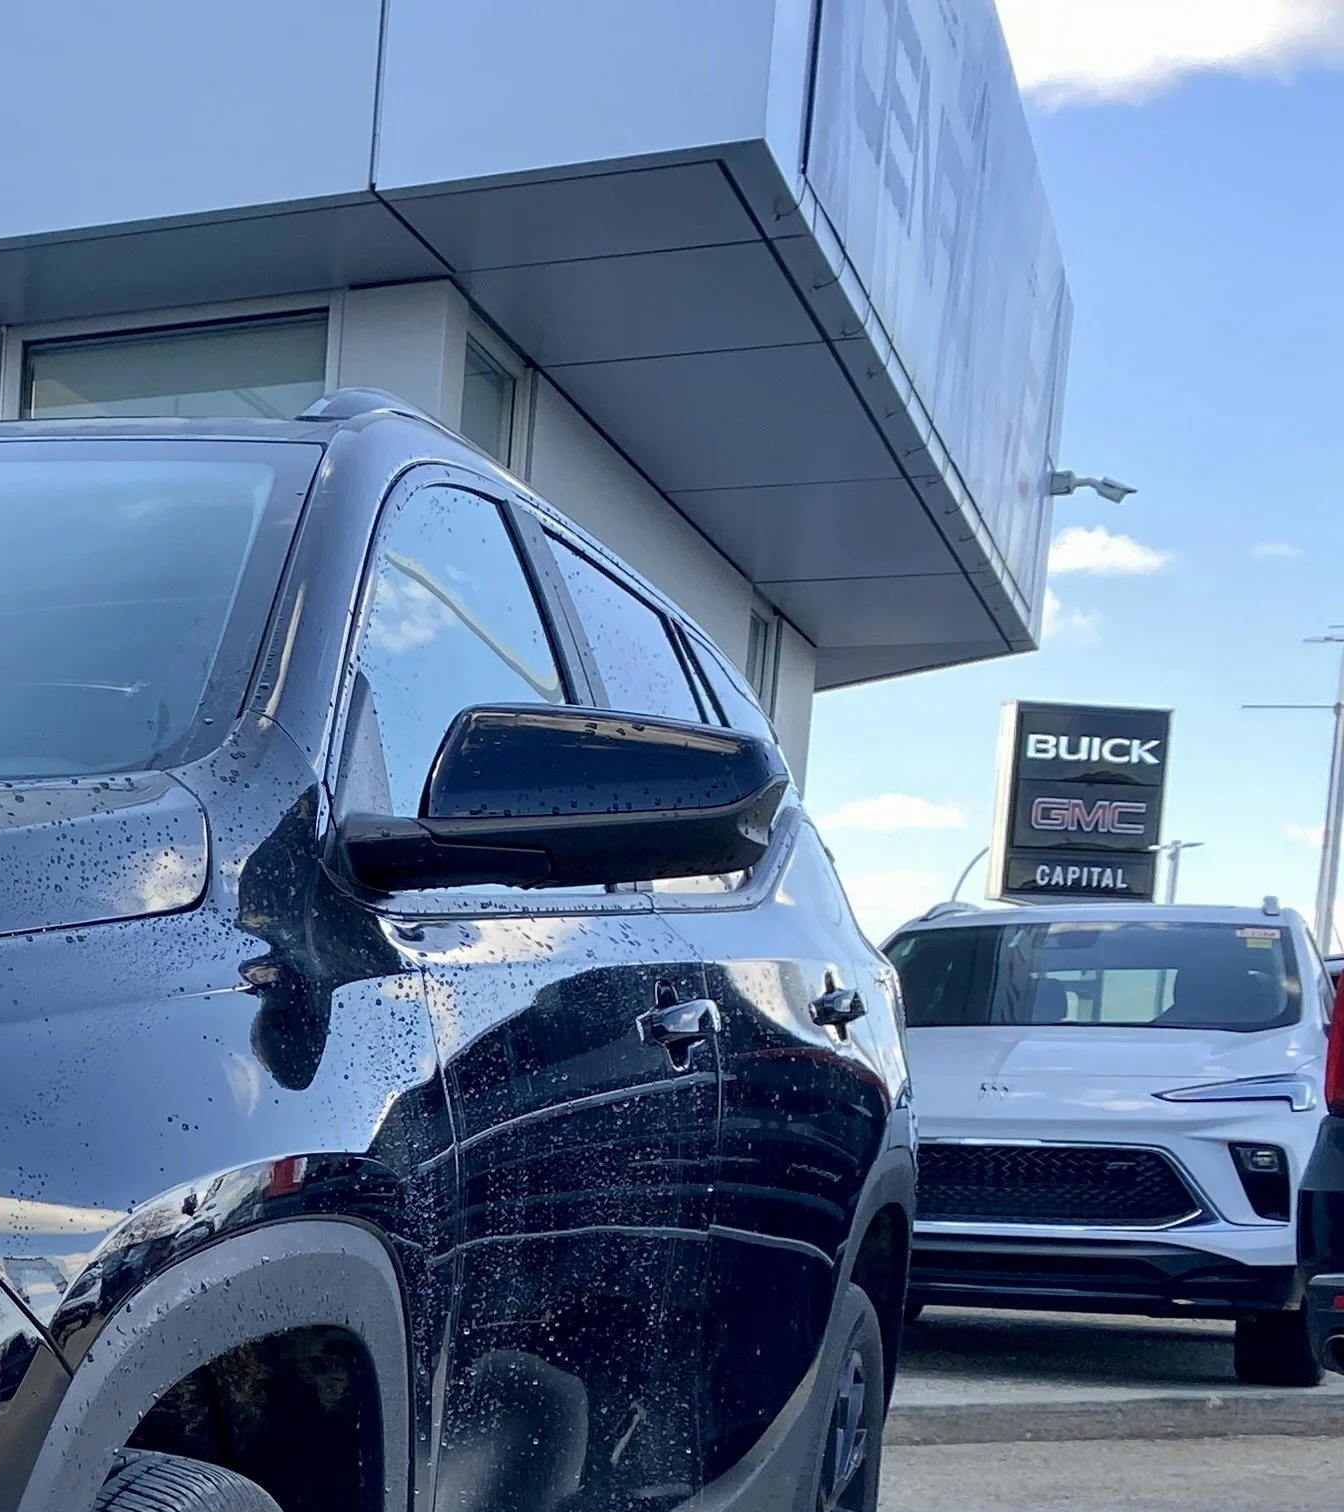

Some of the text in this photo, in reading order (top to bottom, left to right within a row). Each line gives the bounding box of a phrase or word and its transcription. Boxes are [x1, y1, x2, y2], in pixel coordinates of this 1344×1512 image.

[1026, 733, 1161, 765] BUICK
[1031, 797, 1147, 835] GMC
[1035, 864, 1128, 889] CAPITAL
